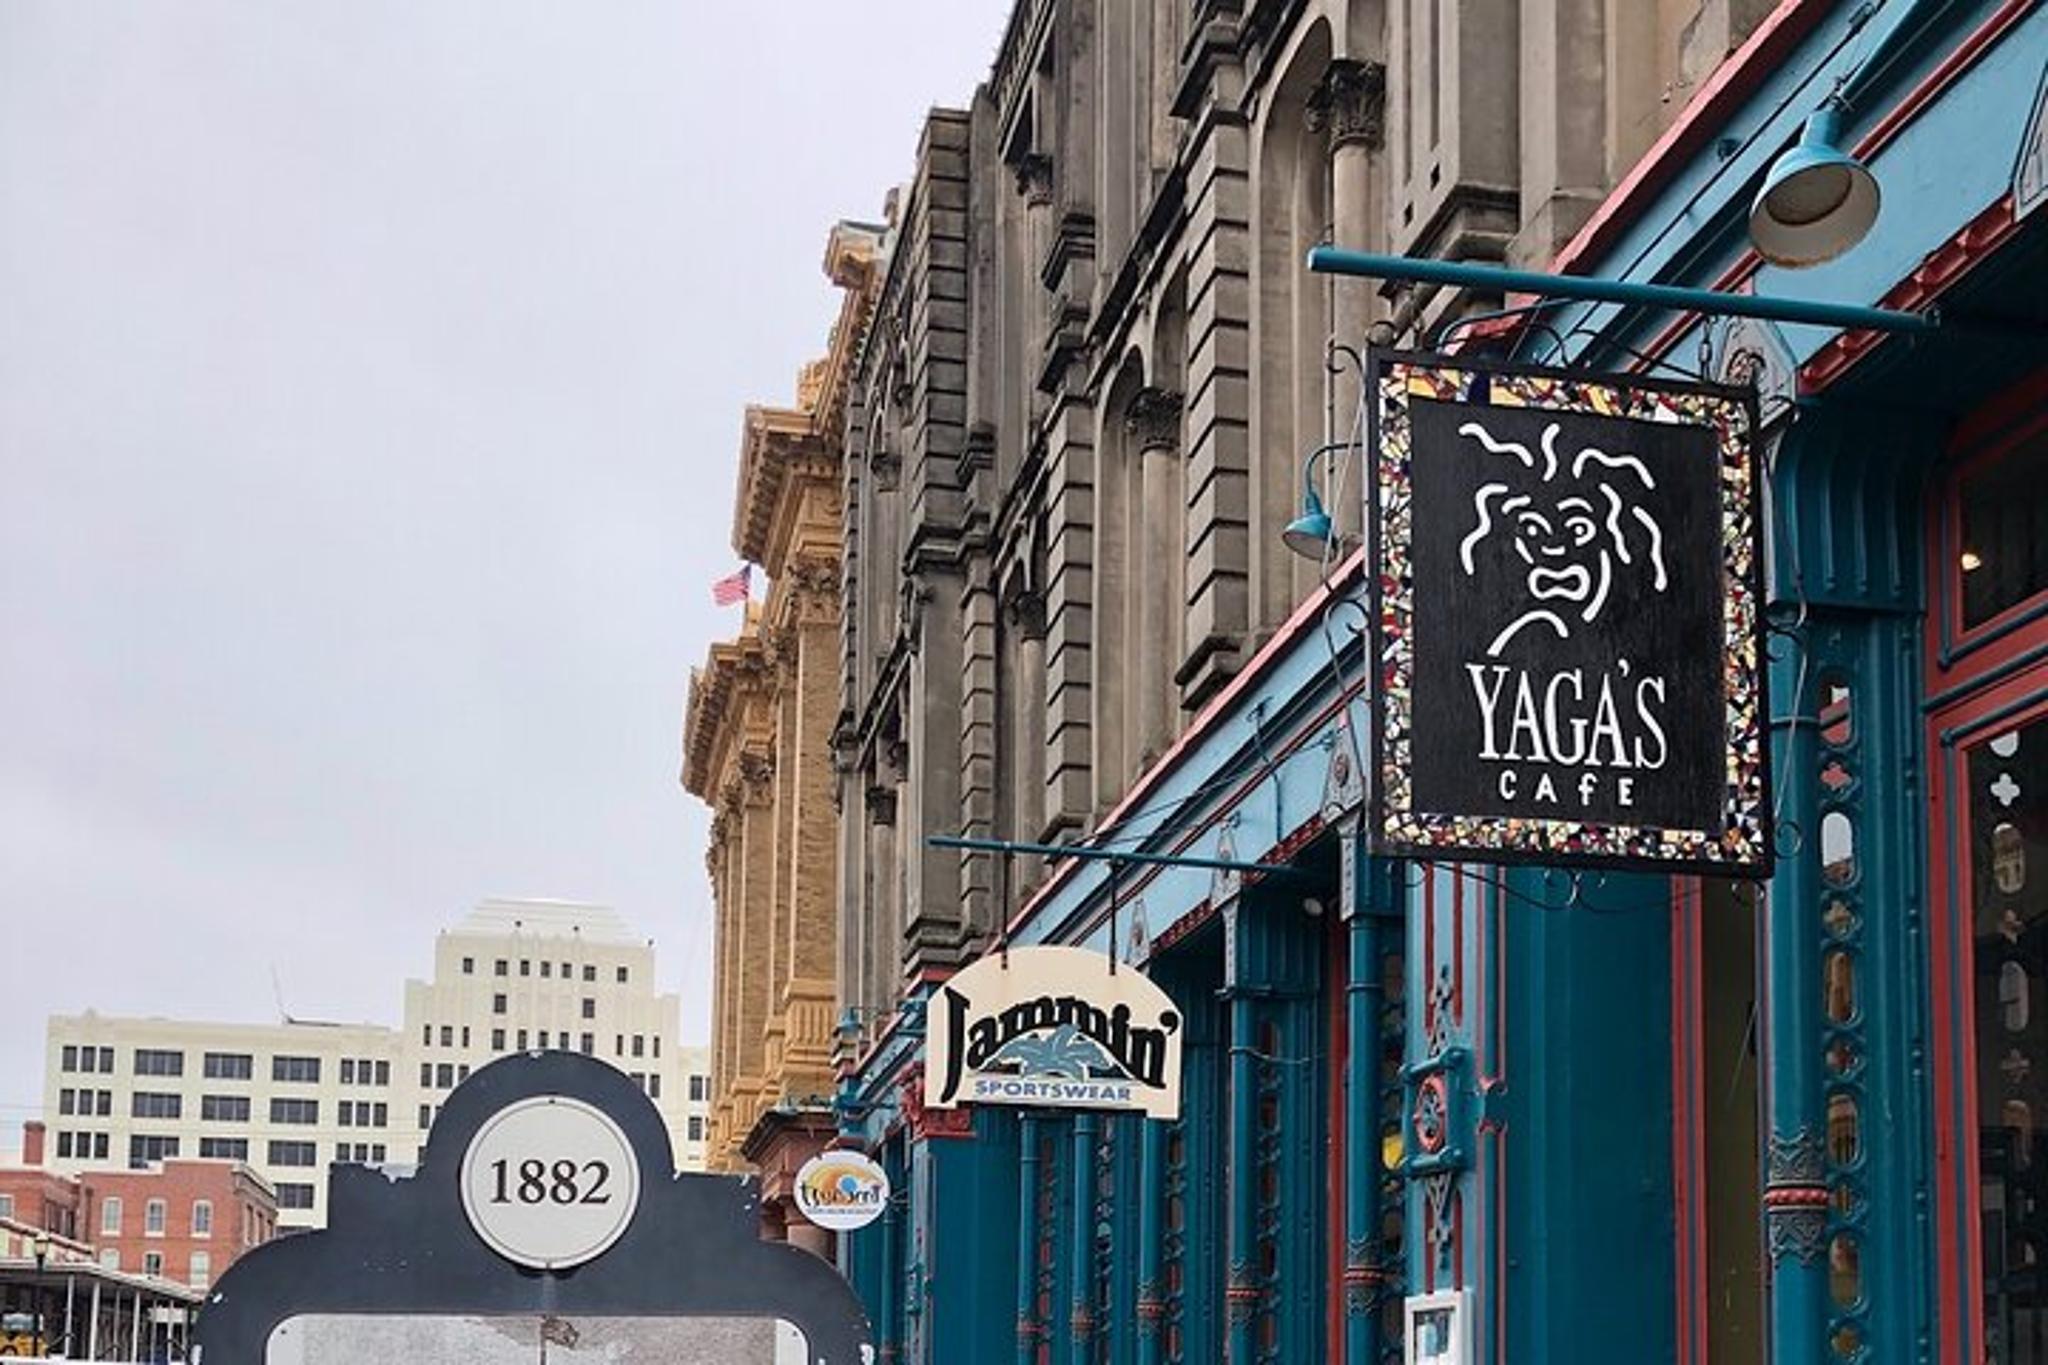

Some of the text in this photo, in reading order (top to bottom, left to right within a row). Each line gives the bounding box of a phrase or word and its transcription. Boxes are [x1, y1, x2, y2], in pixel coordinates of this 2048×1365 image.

[1465, 659, 1667, 770] YAGA'S
[940, 986, 1180, 1103] Jammin'
[975, 1079, 1132, 1101] SPORTSWEAR
[490, 1158, 612, 1206] 1882
